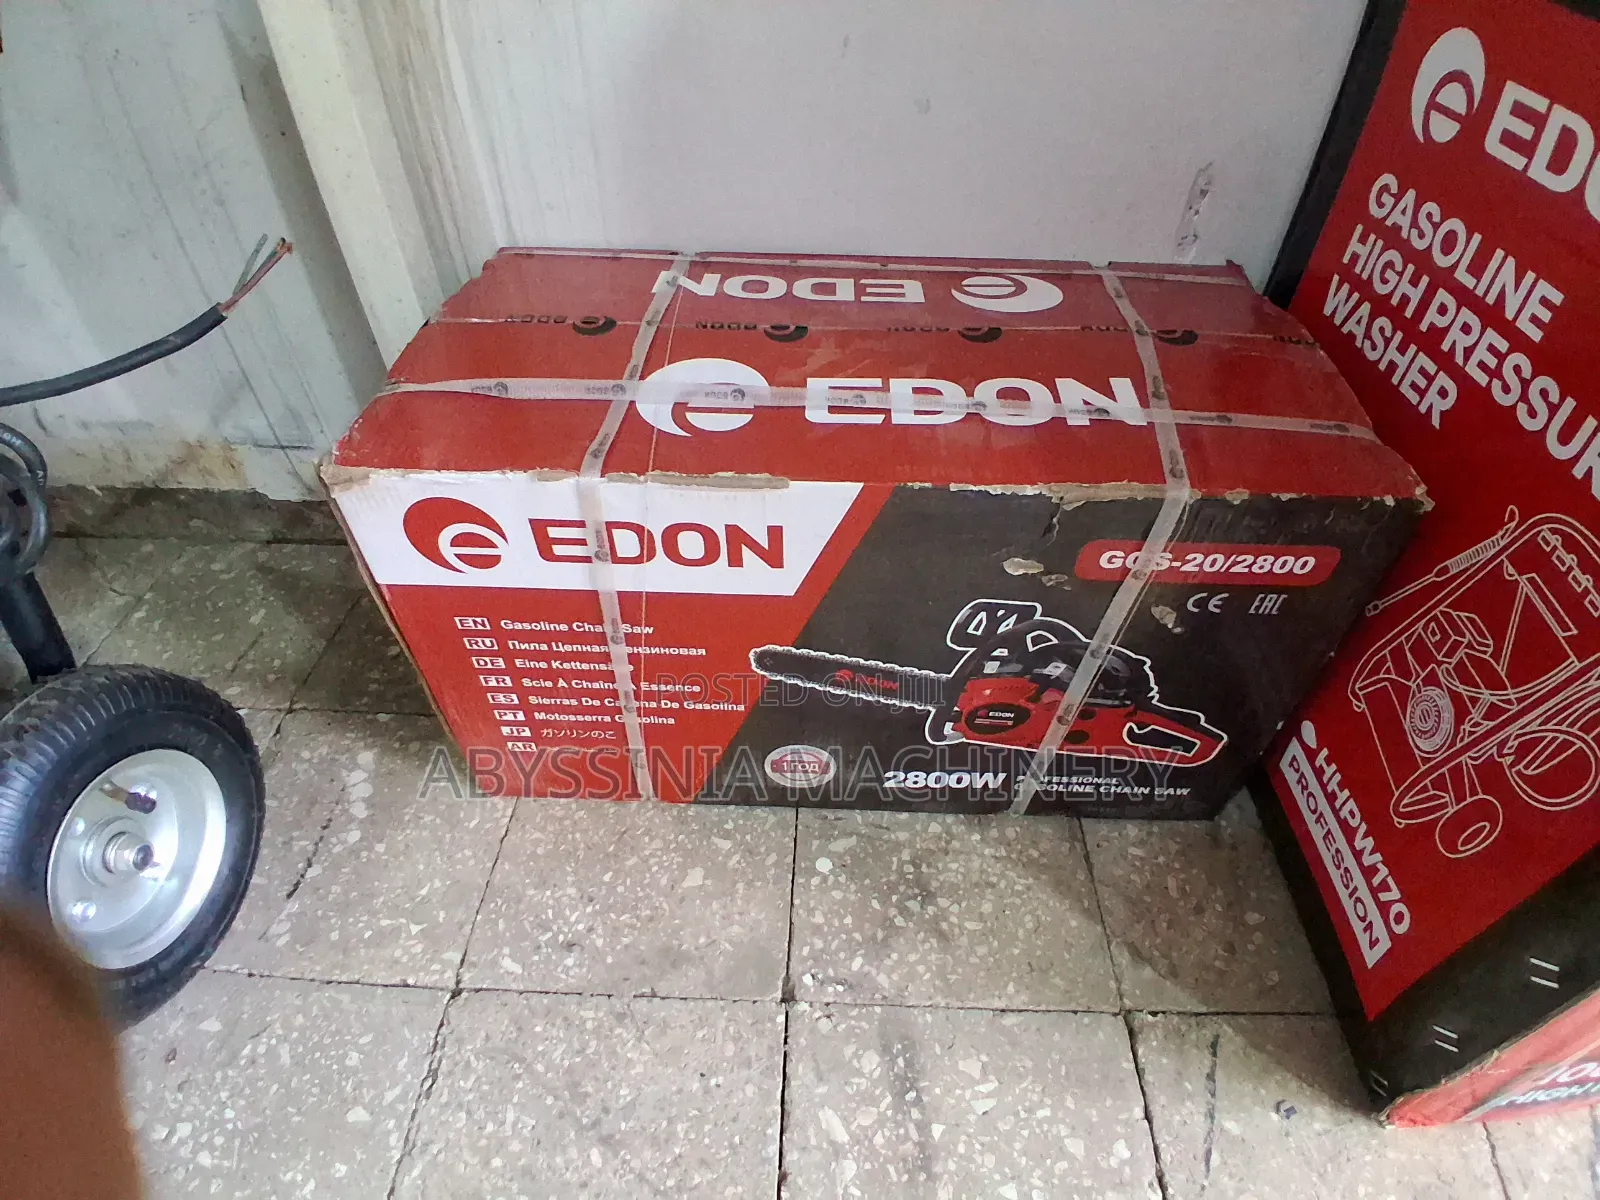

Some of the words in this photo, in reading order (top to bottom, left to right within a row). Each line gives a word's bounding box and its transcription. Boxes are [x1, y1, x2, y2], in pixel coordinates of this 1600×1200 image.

[1368, 173, 1564, 343] GASOLINE
[1342, 224, 1430, 318] HIGH
[652, 270, 926, 303] EDON
[1322, 274, 1458, 430] WASHER
[806, 377, 1148, 427] EDON
[528, 518, 785, 569] EDON
[457, 618, 489, 629] EN
[500, 619, 569, 632] Gasoline
[622, 623, 654, 634] Saw
[464, 638, 497, 649] RU
[508, 640, 549, 651] Пила
[551, 642, 609, 653] Цепная
[473, 658, 505, 668] DE
[514, 659, 548, 669] Eine
[480, 676, 510, 686] FR
[521, 678, 553, 688] Scie
[640, 682, 701, 693] Essence
[488, 694, 517, 704] ES
[528, 695, 578, 706] Sierras
[582, 697, 601, 706] De
[661, 699, 680, 709] De
[683, 700, 745, 712] Gasolina
[495, 711, 523, 720] PT
[533, 711, 612, 722] Motosserra
[988, 711, 1015, 719] EDON
[503, 727, 528, 736] JP
[508, 742, 535, 751] AR
[882, 771, 1008, 789] 2800W
[1099, 784, 1150, 795] CHAIN
[1154, 787, 1192, 796] SAW
[1315, 747, 1411, 935] HHPW170
[1287, 754, 1381, 951] PROFESSION
